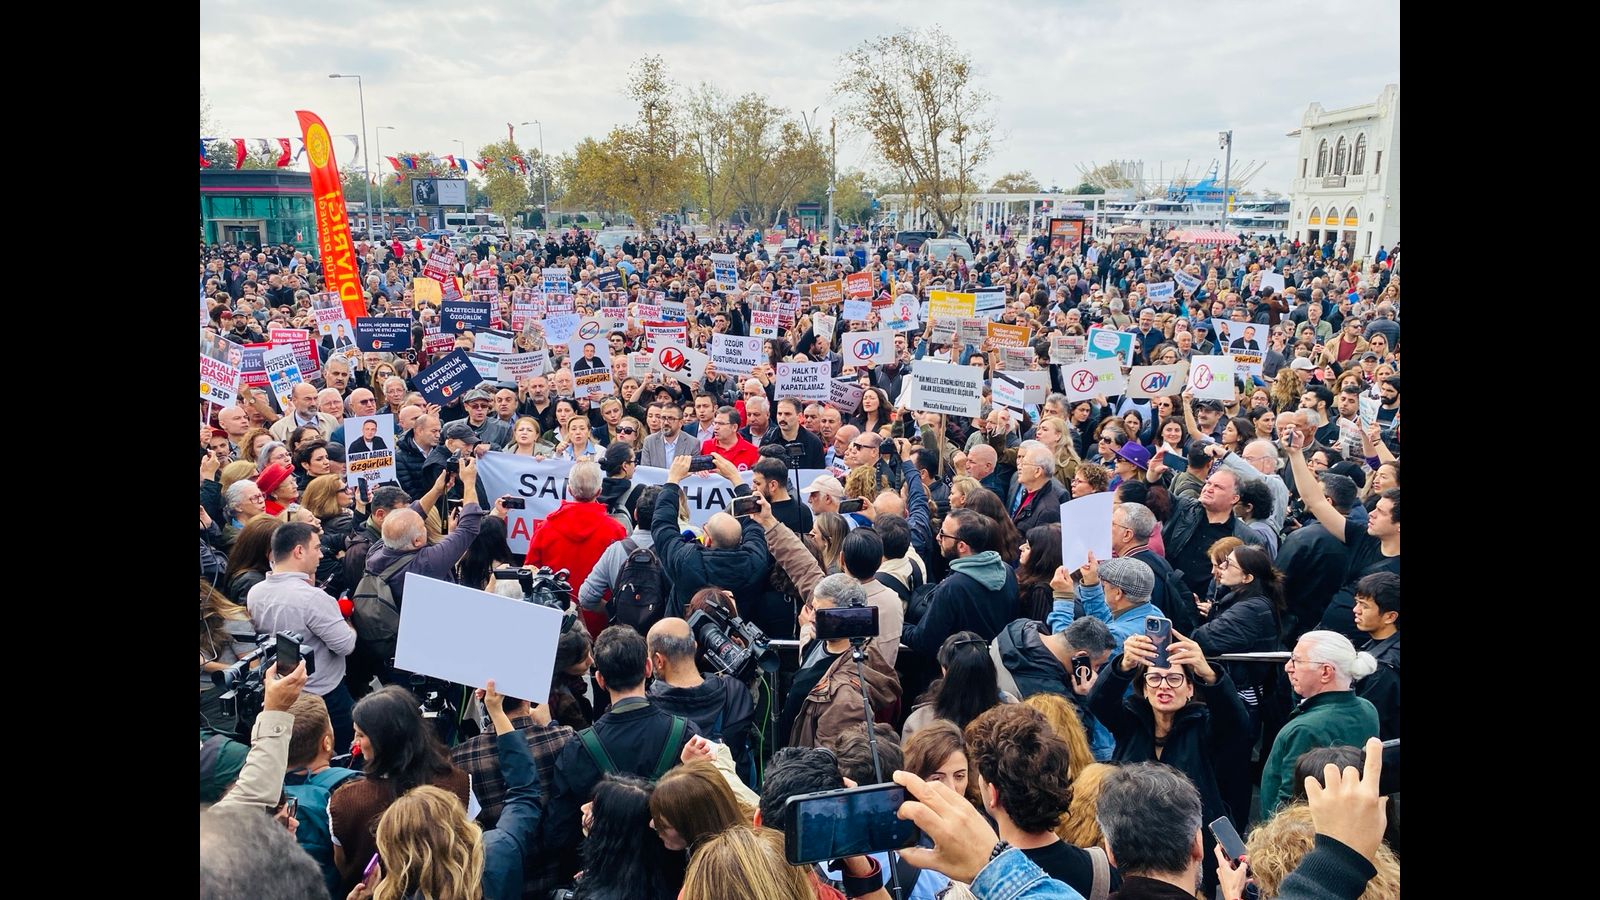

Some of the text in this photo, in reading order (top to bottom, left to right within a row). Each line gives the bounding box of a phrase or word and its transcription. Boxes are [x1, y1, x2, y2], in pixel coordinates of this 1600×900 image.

[319, 313, 342, 322] BASIN
[449, 313, 482, 321] ÖZGÜRLÜK
[754, 316, 775, 326] BASIN
[725, 338, 744, 348] ÖZGÜR
[725, 348, 742, 356] BASIN
[713, 354, 758, 366] SUSTURULAMAZ.
[1234, 355, 1262, 364] zgürlük!
[266, 358, 296, 373] TUTSAK
[421, 356, 462, 385] GAZETECİLİK
[201, 365, 234, 386] BASIN
[791, 367, 809, 375] HALK
[424, 381, 440, 394] SUÇ
[438, 363, 468, 385] DEĞİLDİR
[576, 374, 610, 385] özgürlük!
[780, 383, 825, 391] KAPATILAMAZ.
[211, 387, 230, 400] SEP
[830, 389, 844, 398] ASIN
[923, 401, 939, 410] Mustafa
[348, 453, 368, 462] MURAT
[350, 457, 393, 472] özgürlük!
